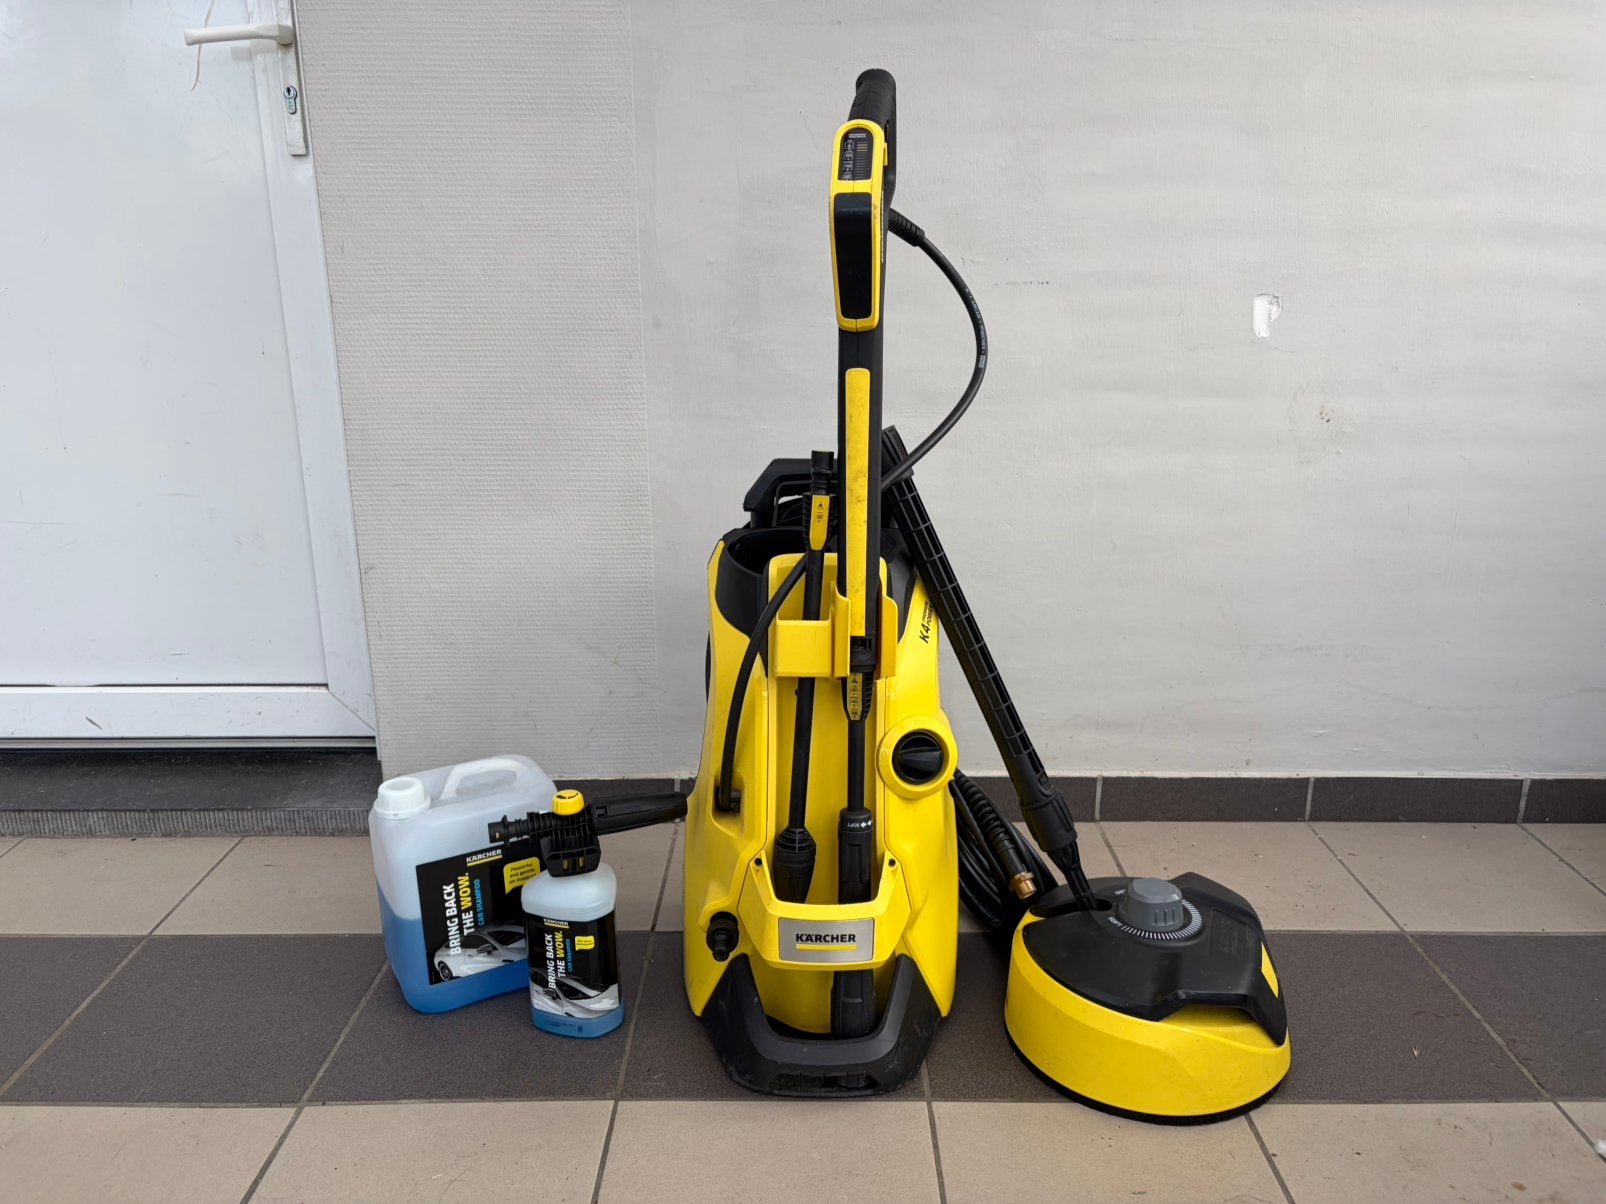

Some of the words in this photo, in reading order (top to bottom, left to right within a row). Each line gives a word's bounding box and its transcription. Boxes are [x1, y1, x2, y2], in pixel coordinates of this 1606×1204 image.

[443, 883, 459, 917] BACK
[457, 872, 474, 910] WOW.
[473, 879, 483, 912] SHAMPOO
[461, 910, 475, 936] THE
[477, 912, 485, 926] CAR
[447, 917, 462, 956] BRING
[544, 933, 554, 959] BACK
[795, 933, 857, 943] KÄRCHER
[546, 960, 556, 990] BRING
[556, 960, 566, 978] THE
